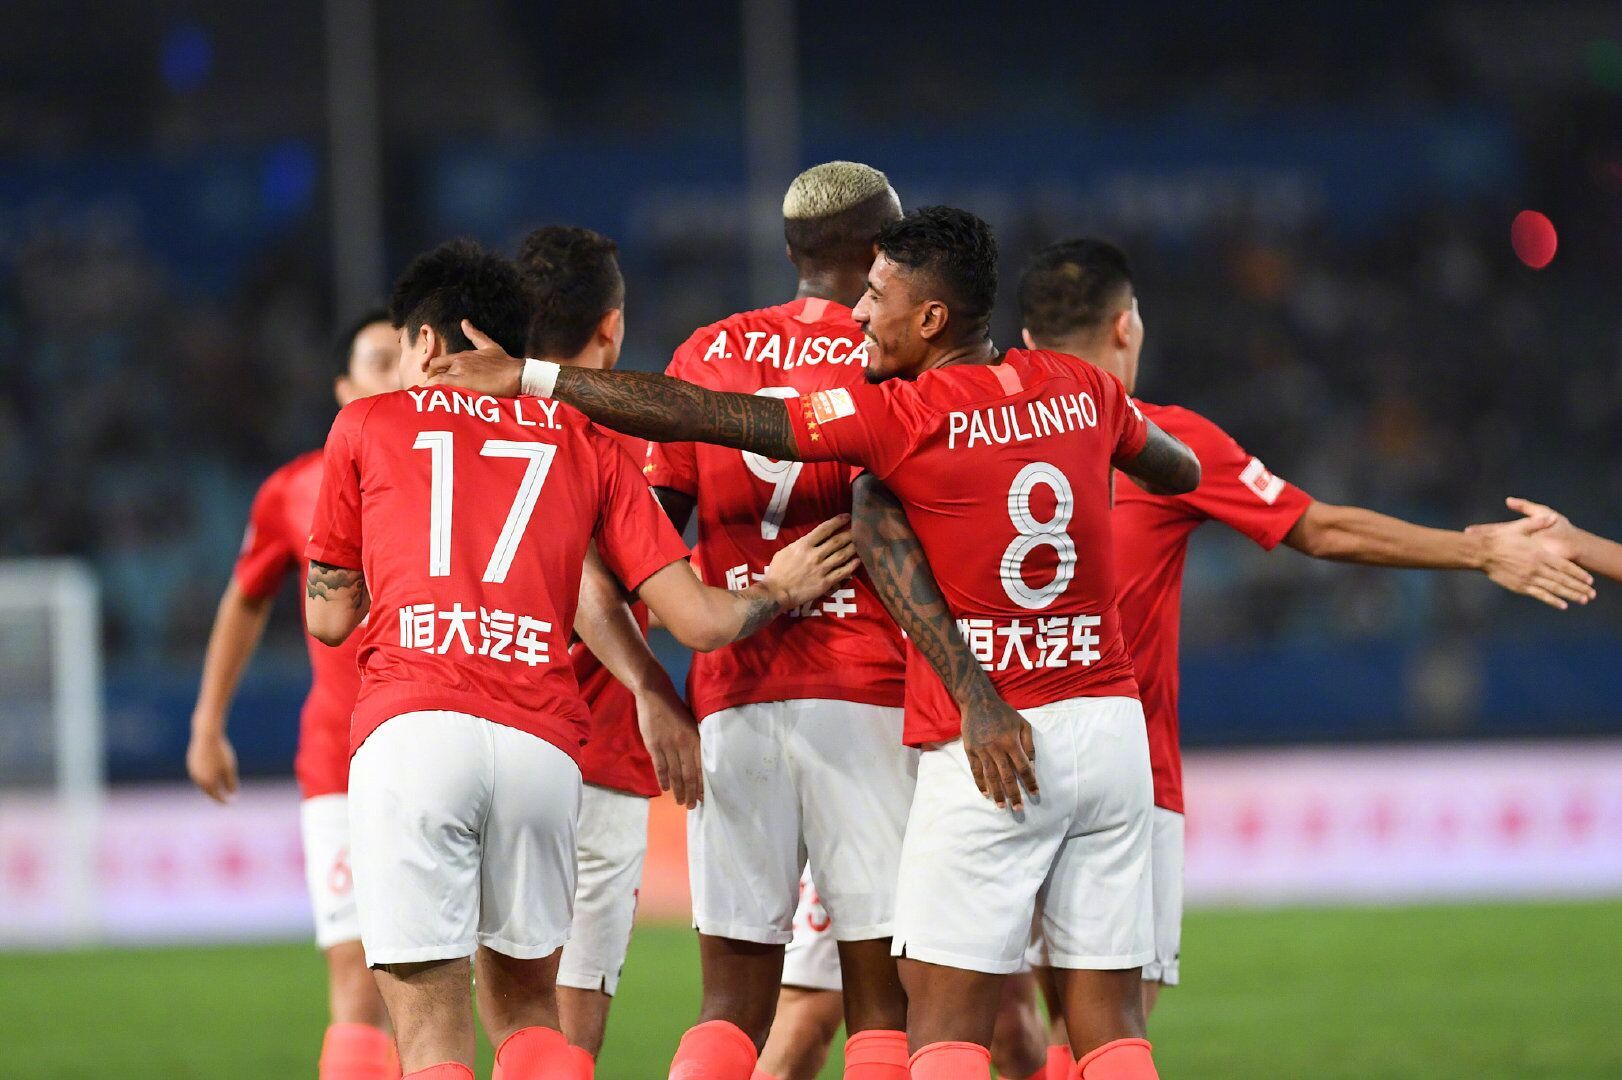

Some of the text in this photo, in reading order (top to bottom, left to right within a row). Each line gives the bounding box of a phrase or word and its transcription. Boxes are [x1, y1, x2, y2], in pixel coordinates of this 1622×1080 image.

[703, 330, 869, 371] A. TALISCA
[407, 389, 562, 429] YANG L.Y.
[948, 391, 1098, 450] PAULINHO
[412, 431, 557, 584] 17
[1000, 461, 1077, 610] 8
[399, 602, 552, 667] 恒大汽车
[955, 614, 1102, 672] 恒大汽车
